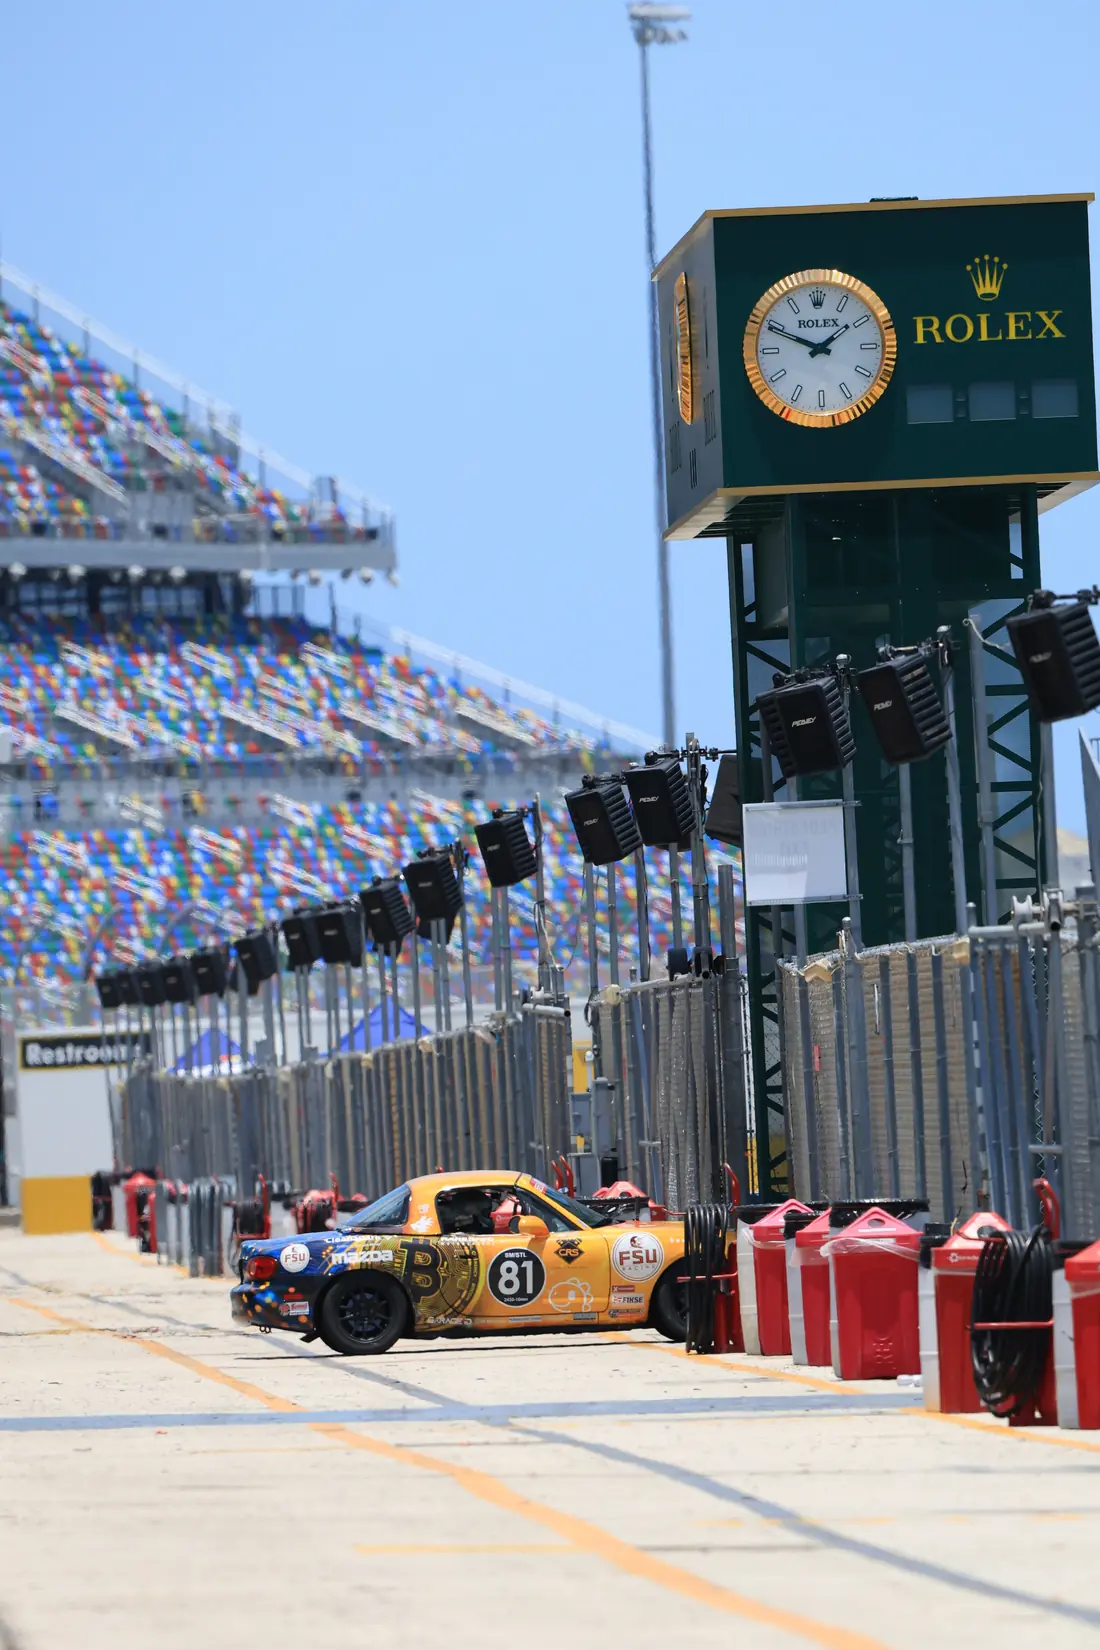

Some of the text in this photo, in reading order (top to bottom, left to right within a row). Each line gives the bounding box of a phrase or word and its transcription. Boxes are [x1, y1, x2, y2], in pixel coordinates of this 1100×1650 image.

[797, 318, 839, 328] ROLEX
[912, 310, 1066, 344] ROLEX
[284, 1252, 306, 1263] FSU
[558, 1248, 579, 1257] CRS
[619, 1249, 657, 1266] FSU
[498, 1260, 533, 1295] 81
[623, 1296, 644, 1304] FIKSE
